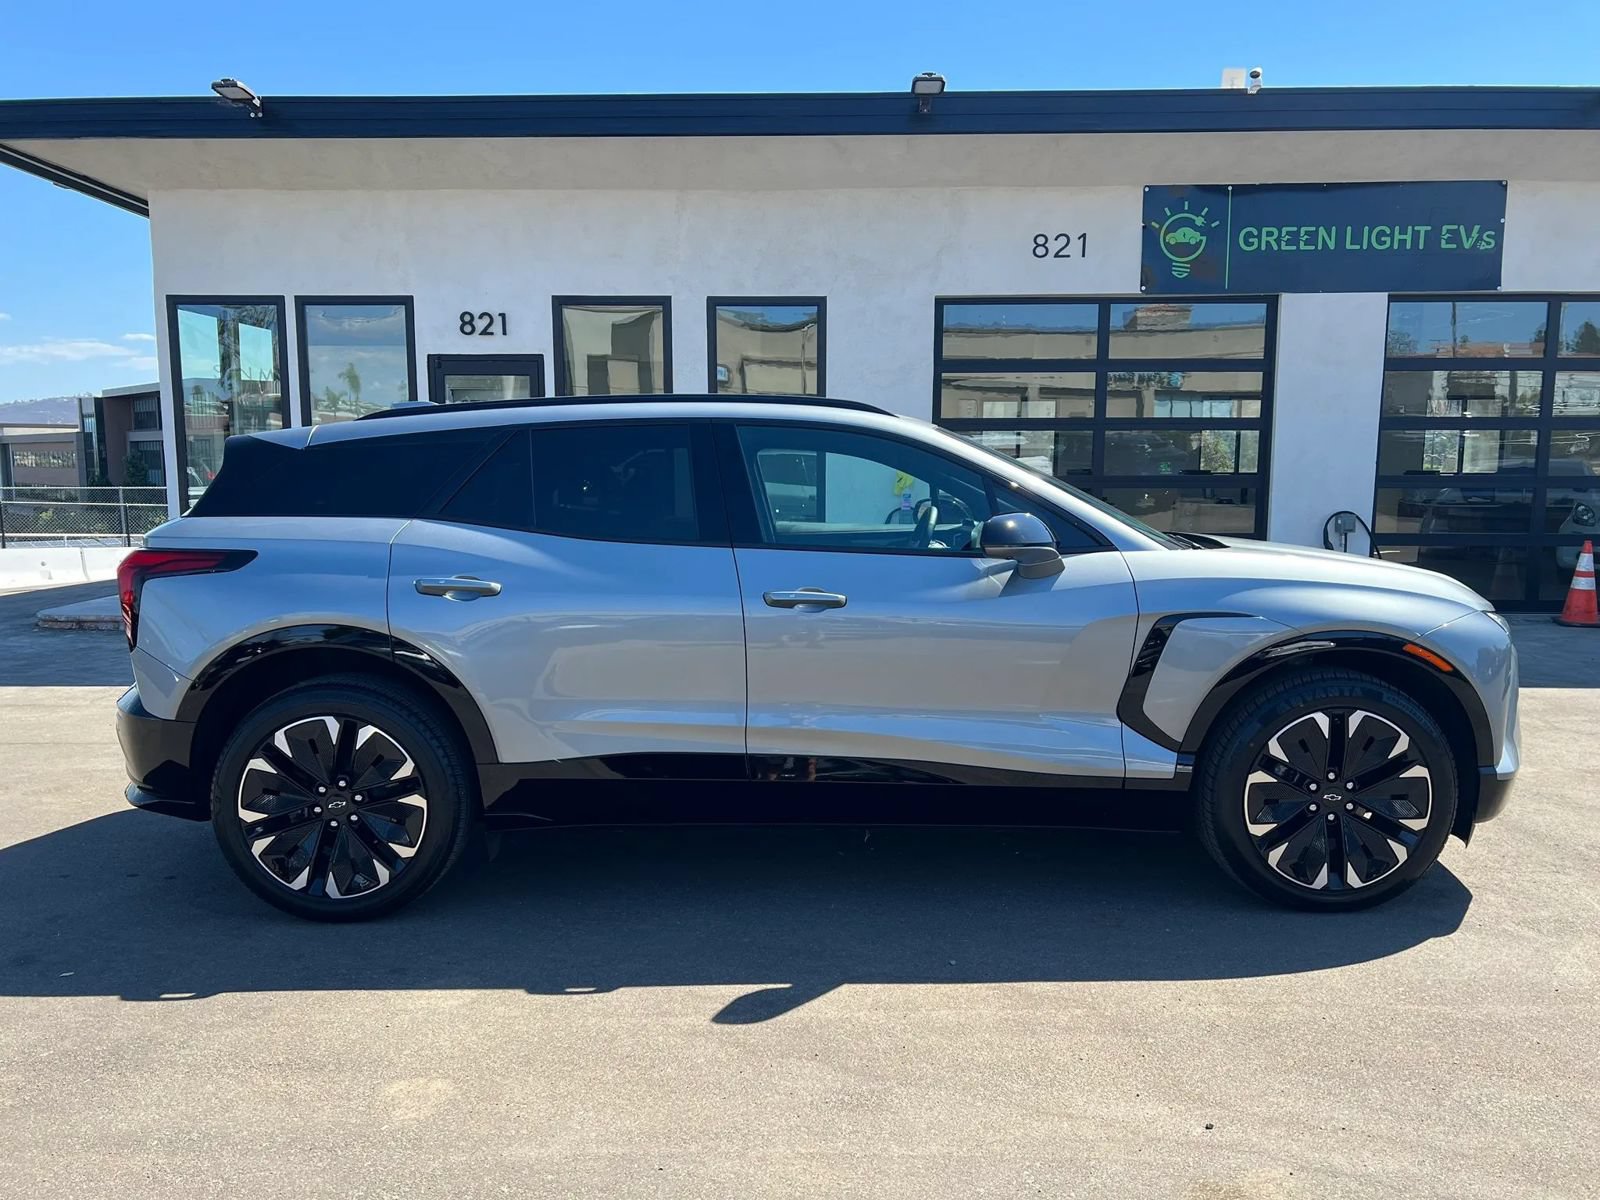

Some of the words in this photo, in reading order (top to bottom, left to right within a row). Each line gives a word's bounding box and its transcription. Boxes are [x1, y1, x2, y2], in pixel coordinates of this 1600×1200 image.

[1032, 232, 1087, 259] 821
[1238, 226, 1336, 251] GREEN
[1345, 225, 1432, 250] LIGHT
[1440, 224, 1496, 250] EVs
[459, 311, 508, 336] 821
